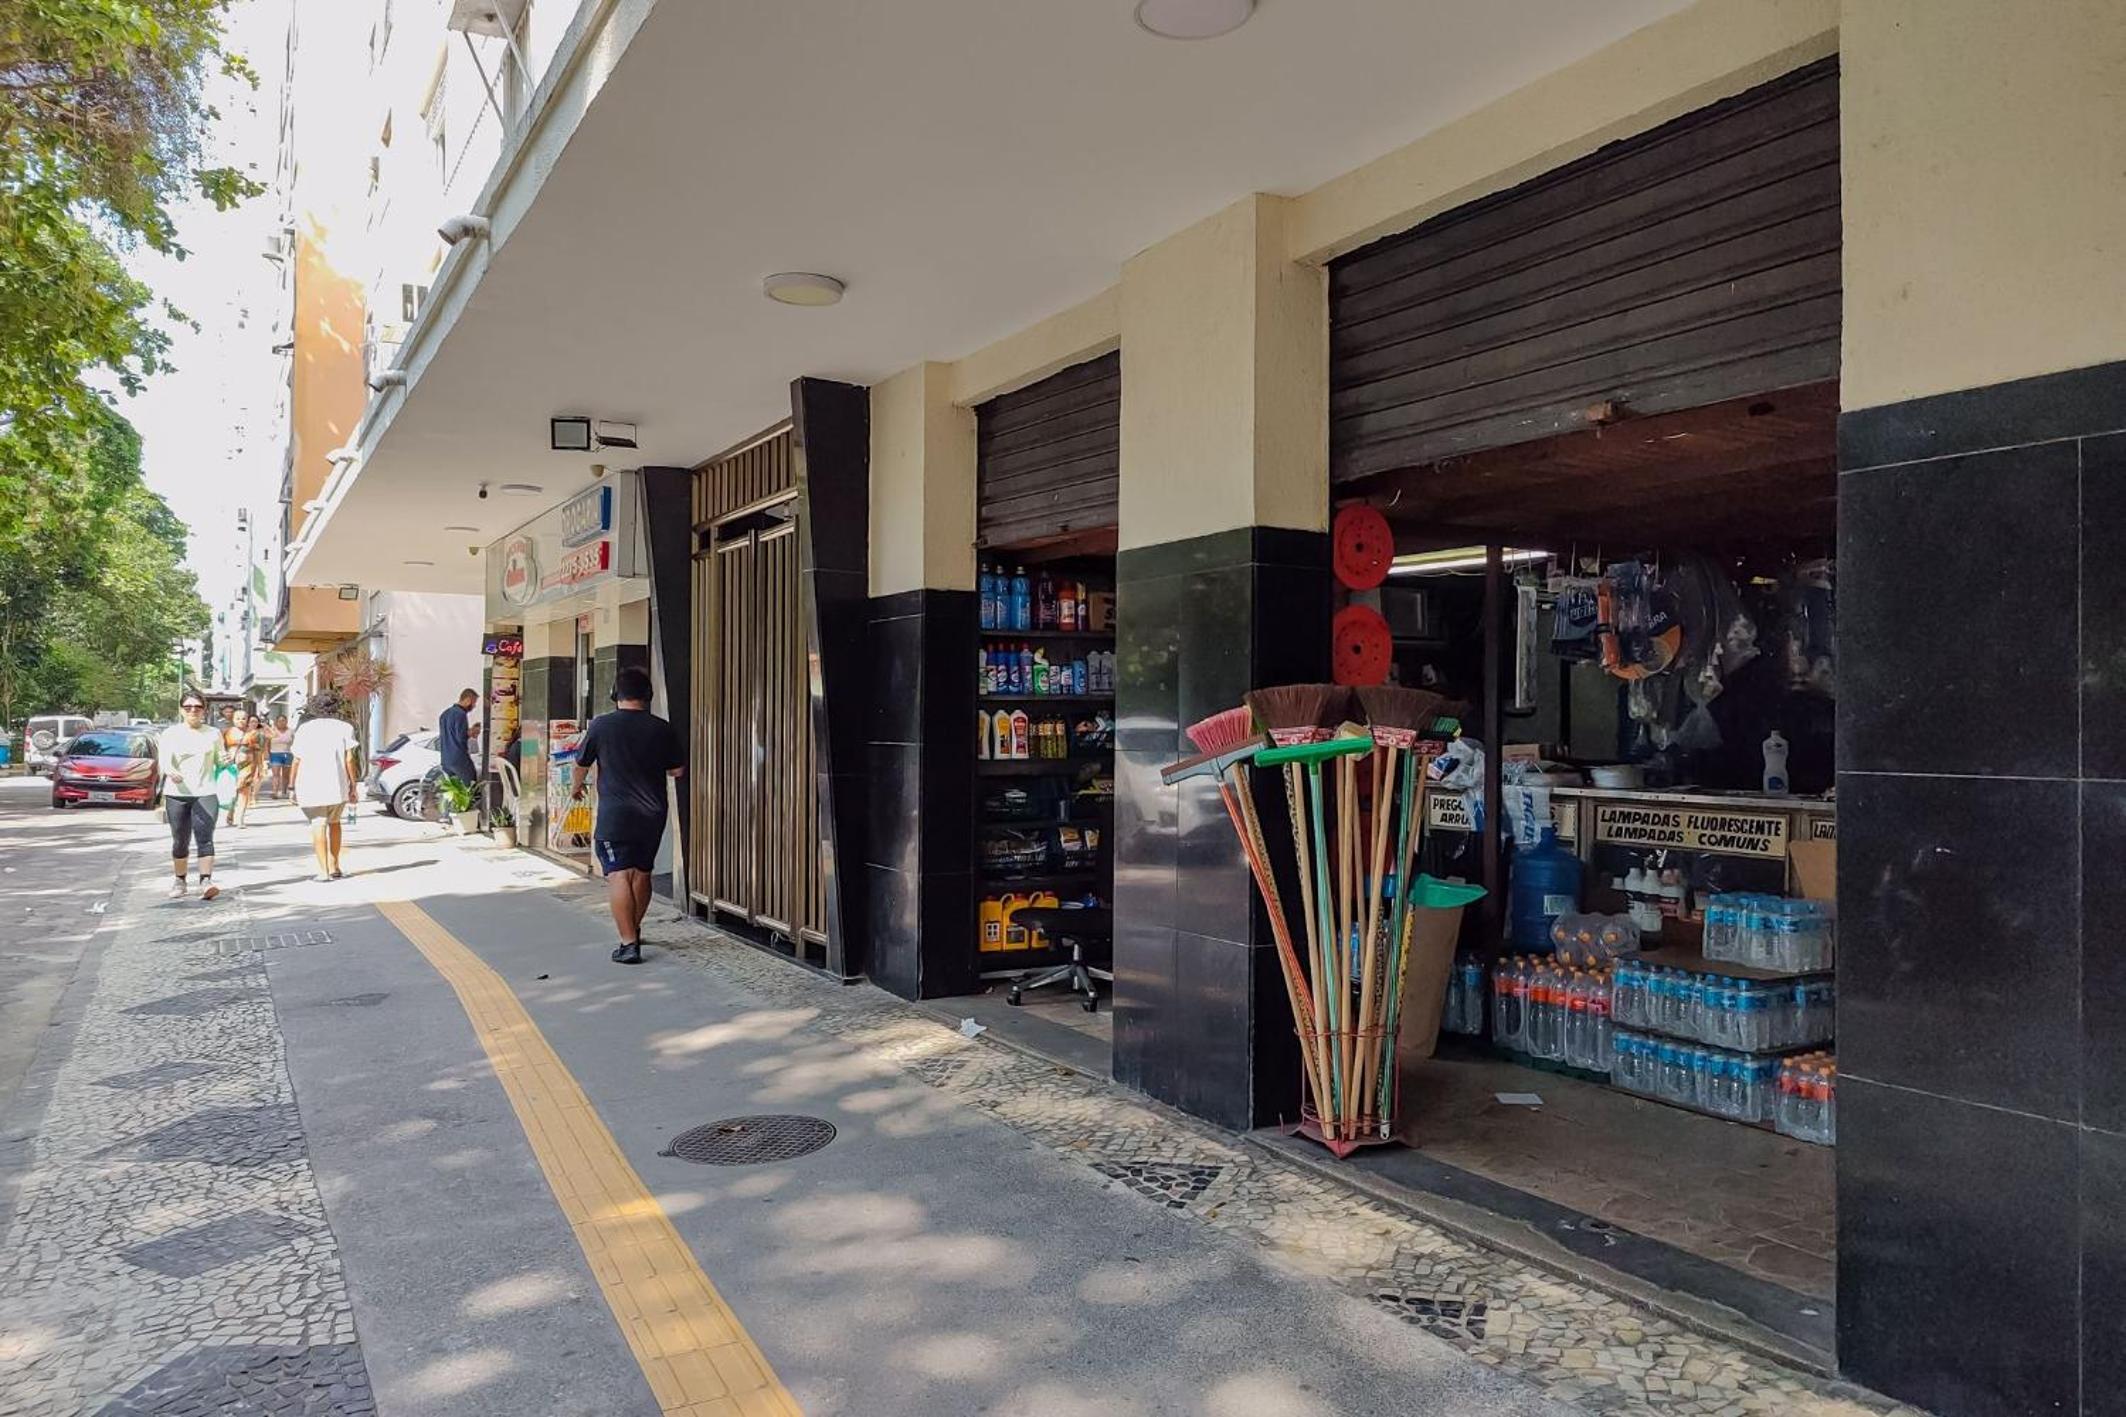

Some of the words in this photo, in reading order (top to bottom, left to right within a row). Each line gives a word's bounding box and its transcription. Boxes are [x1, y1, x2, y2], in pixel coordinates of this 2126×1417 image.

[1600, 809, 1681, 828] LAMPADAS
[1686, 815, 1782, 837] FLUORESCENTE
[1607, 826, 1685, 843] LAMPADAS
[1697, 832, 1772, 852] COMUNS
